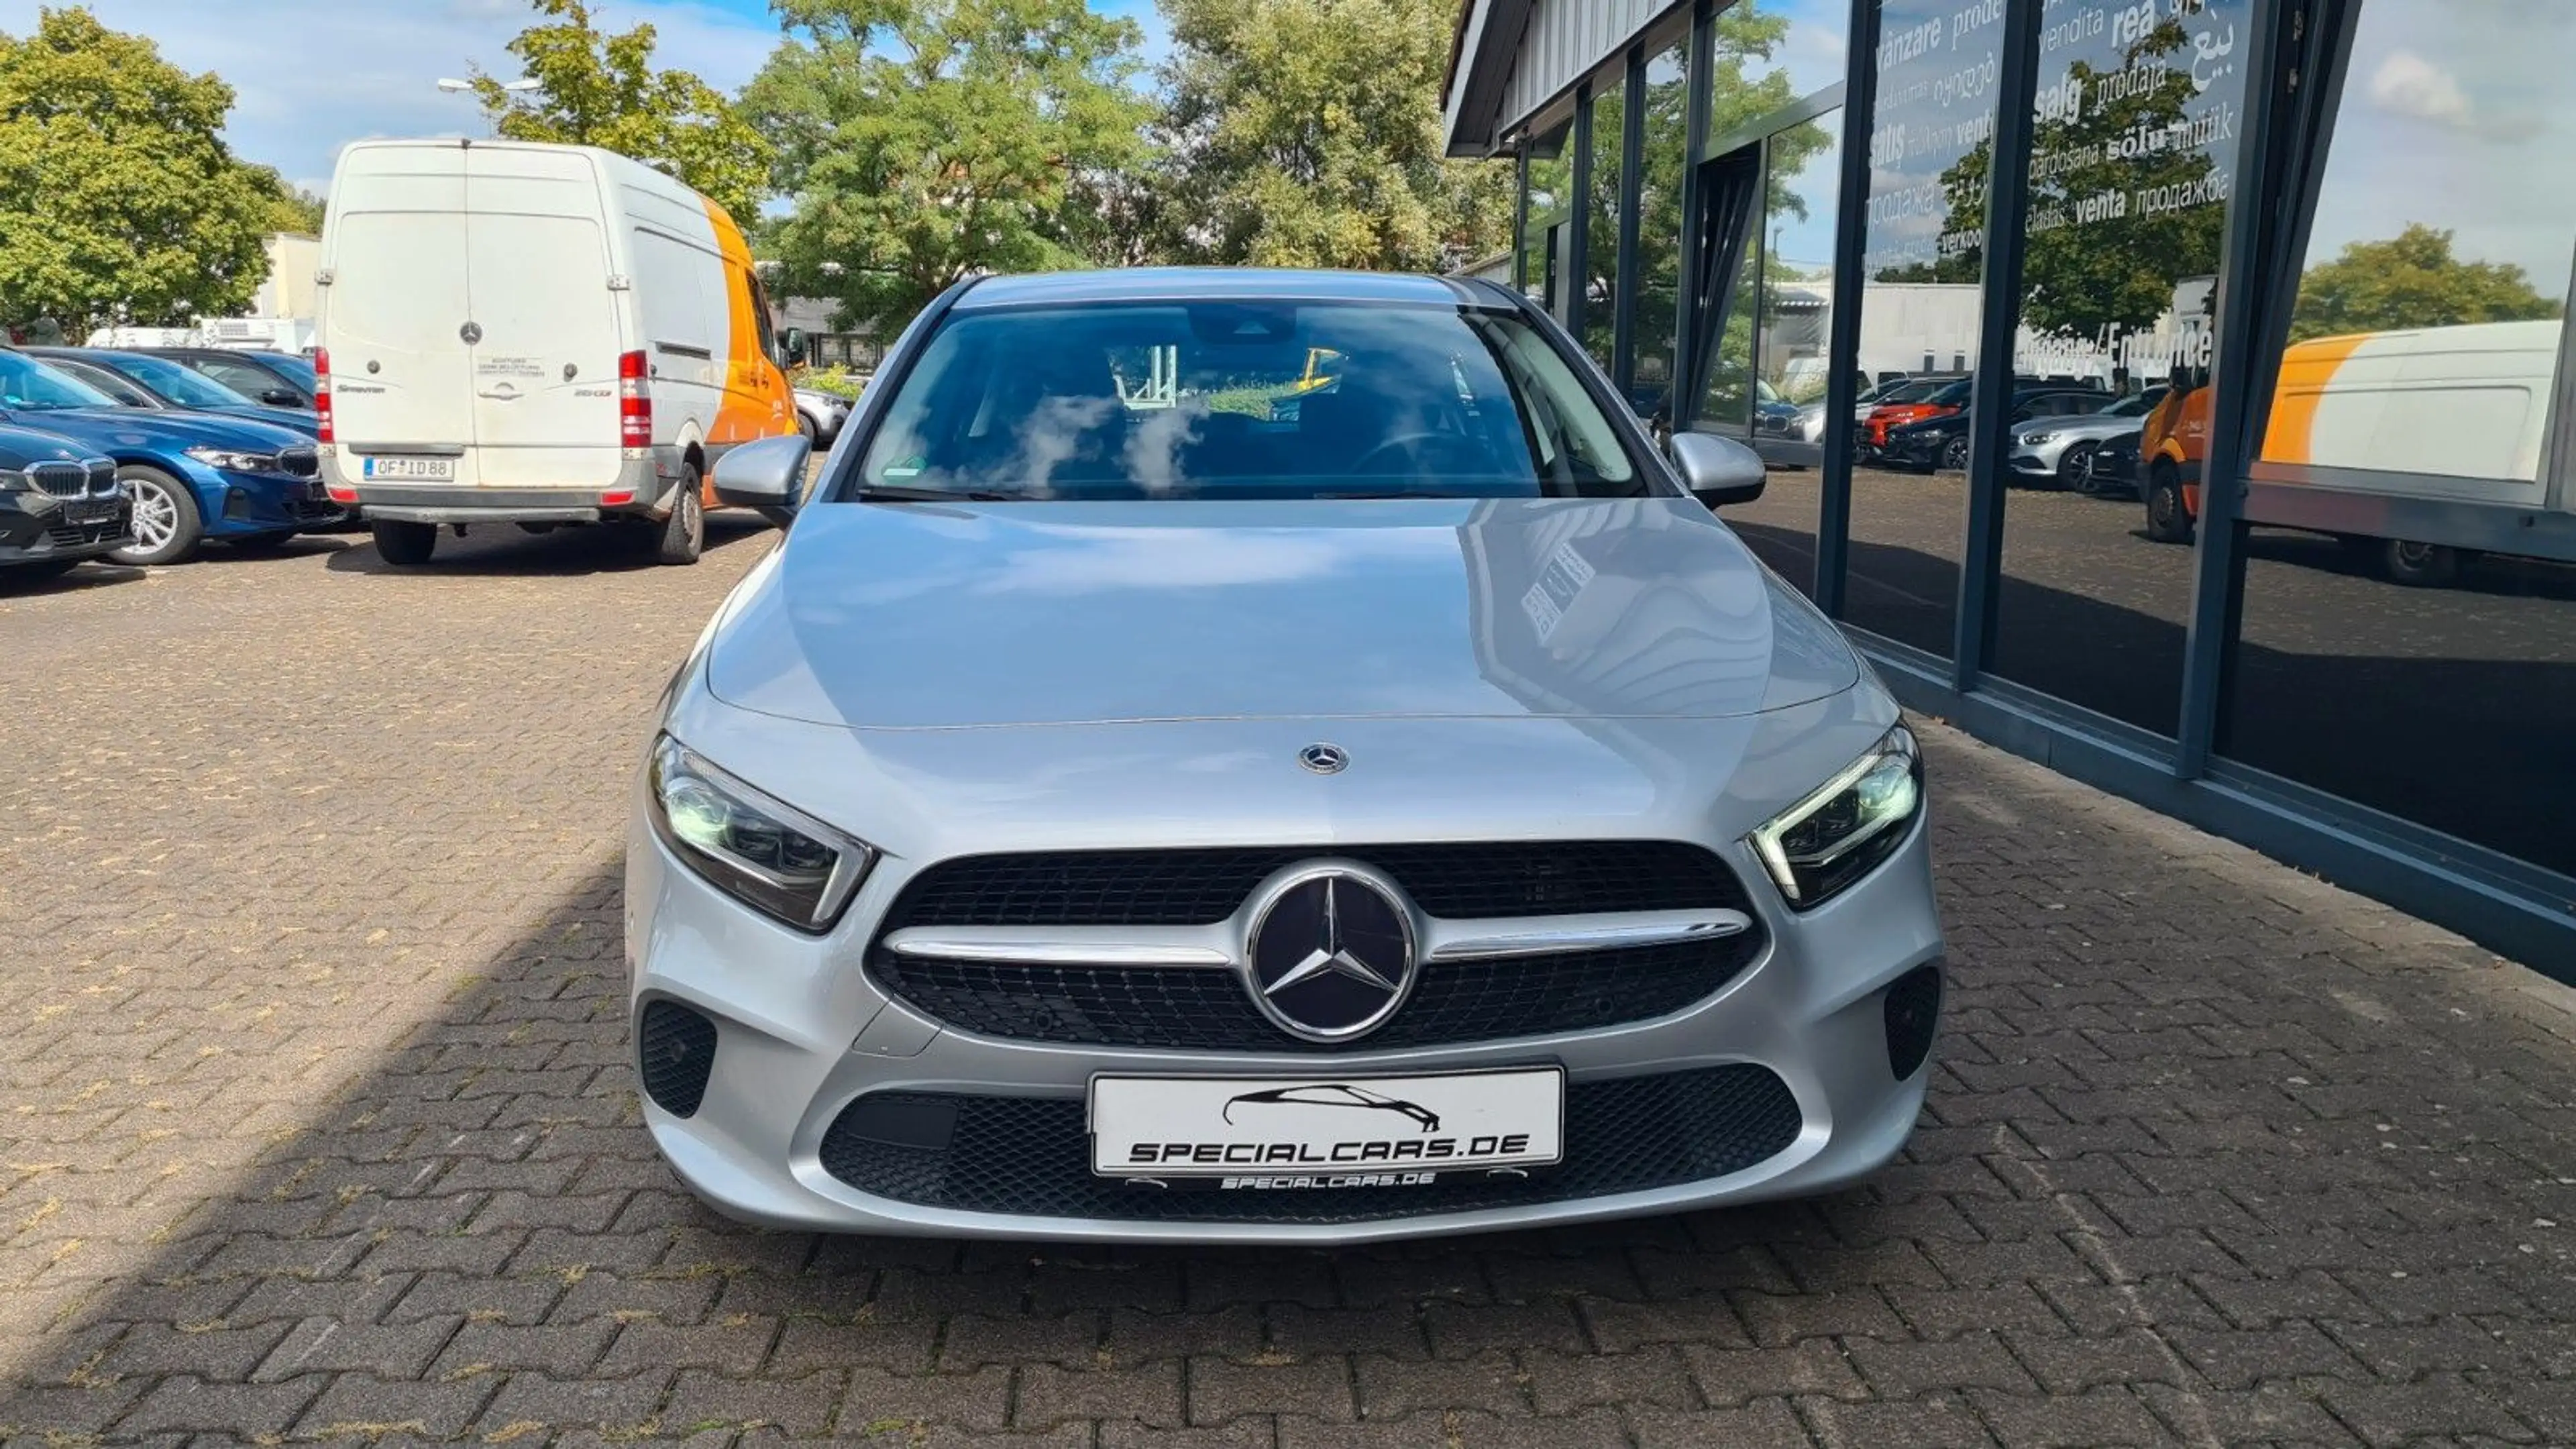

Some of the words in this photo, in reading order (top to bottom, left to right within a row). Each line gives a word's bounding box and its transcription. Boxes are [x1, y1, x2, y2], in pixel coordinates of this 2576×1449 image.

[2039, 7, 2104, 54] vendita
[2032, 70, 2082, 126] salg
[2097, 52, 2167, 116] prodaja
[2076, 189, 2127, 223] venta
[378, 460, 398, 475] OF
[1128, 1134, 1530, 1163] SPECIALCARS.DE
[1221, 1173, 1436, 1190] SPECIALCARS.DE
